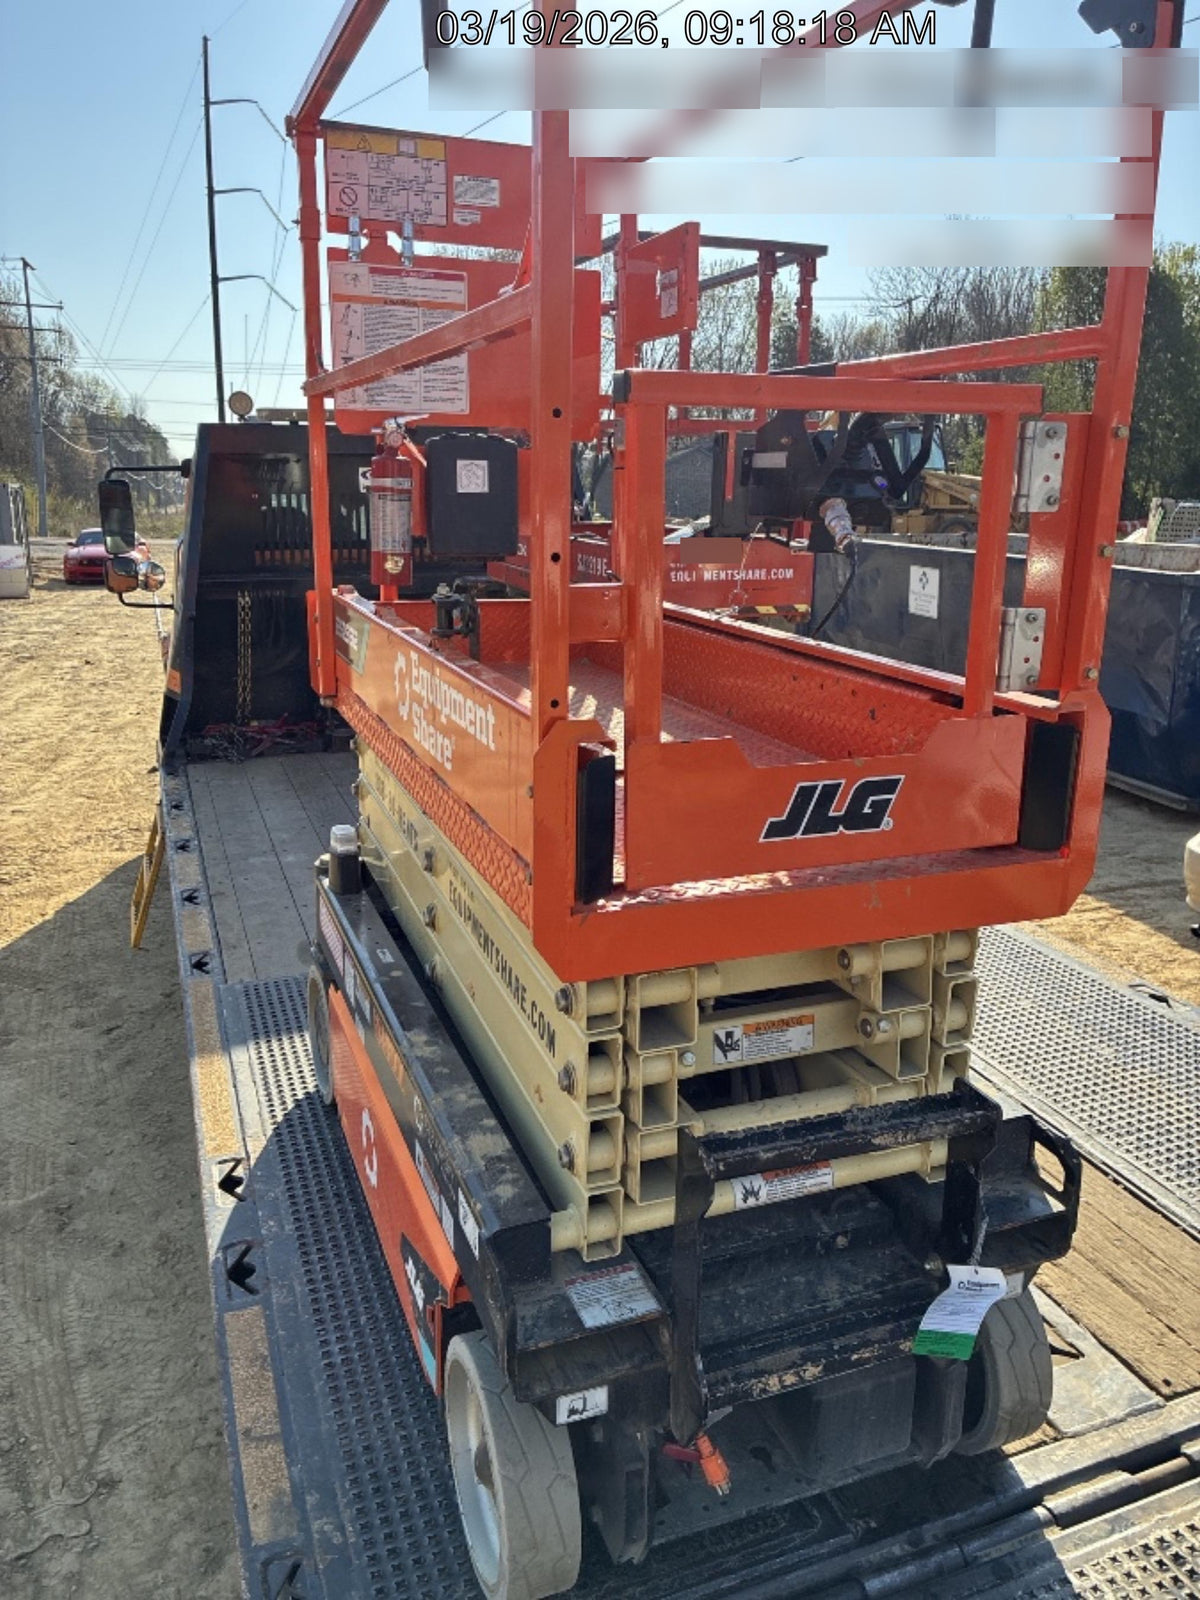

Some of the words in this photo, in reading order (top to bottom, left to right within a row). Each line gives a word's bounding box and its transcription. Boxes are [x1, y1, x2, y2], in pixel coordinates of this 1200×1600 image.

[670, 568, 794, 582] EQUIMENTSHARE.COM
[410, 650, 495, 751] Equipment
[412, 702, 452, 771] Share
[759, 775, 905, 842] JLG
[449, 879, 556, 1058] EQUIPMENTSHARE.COM
